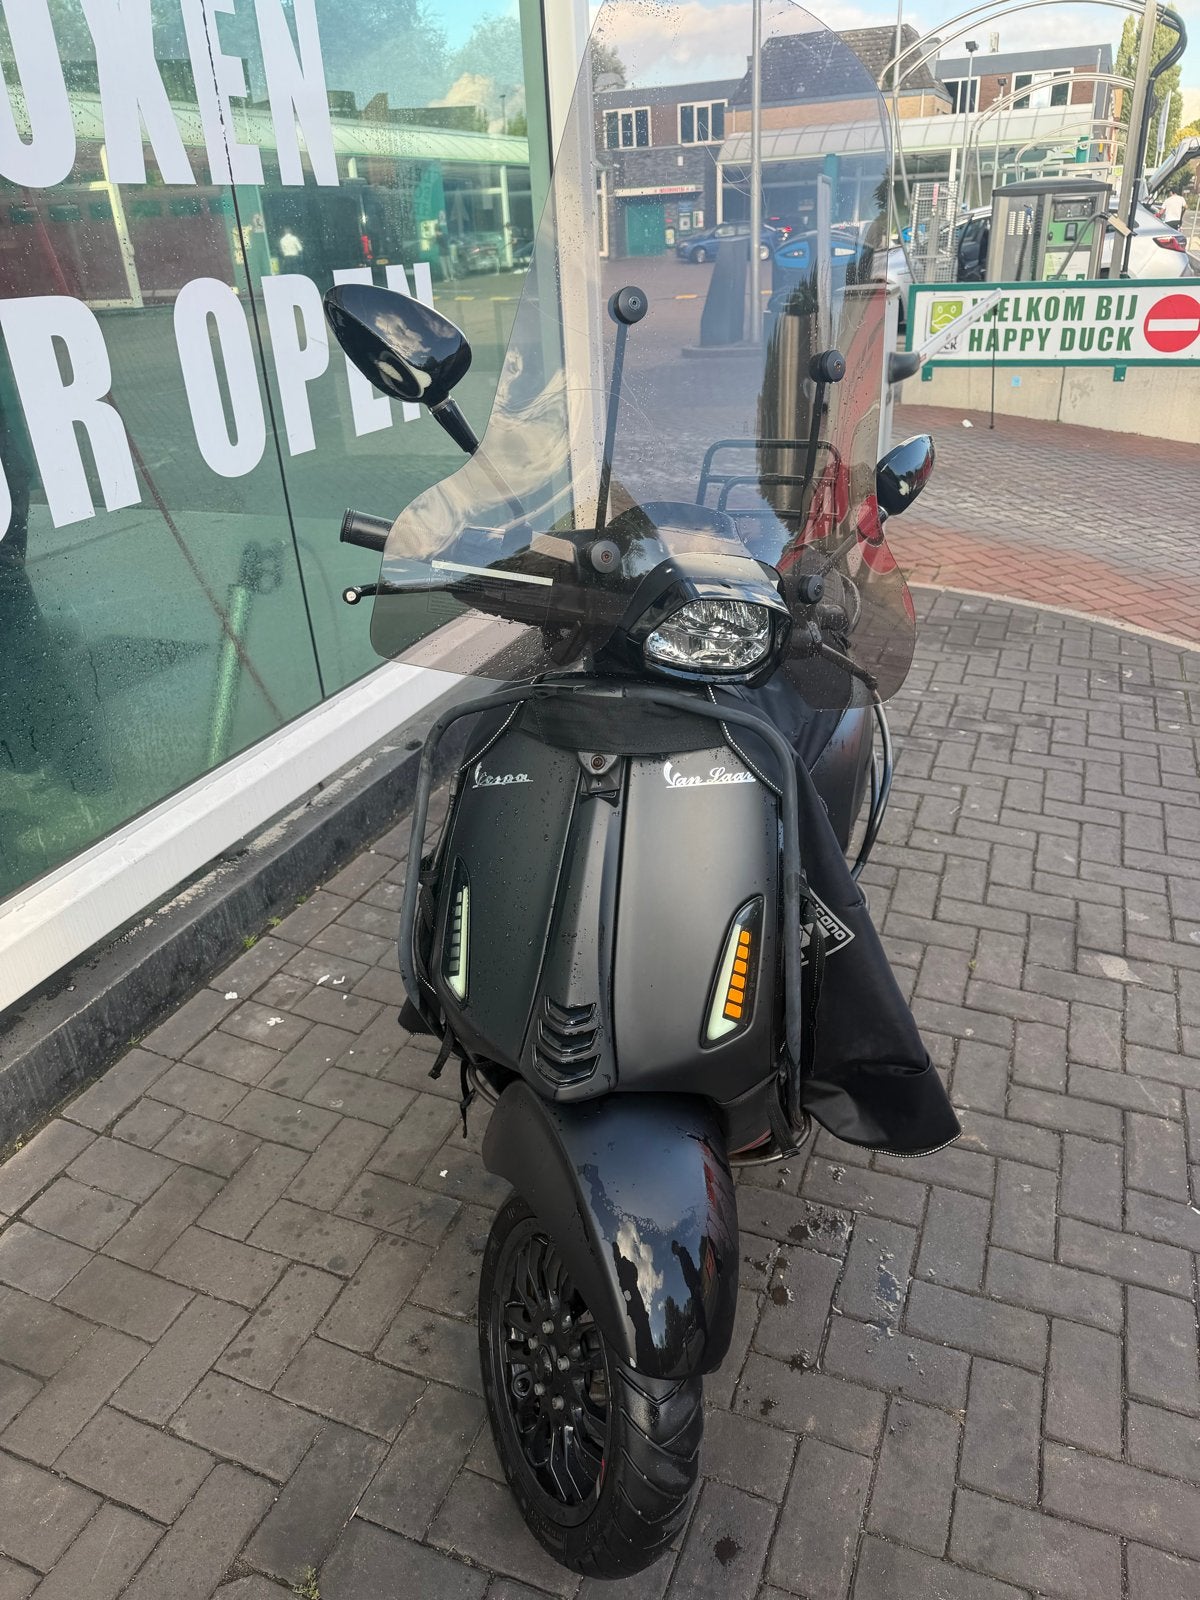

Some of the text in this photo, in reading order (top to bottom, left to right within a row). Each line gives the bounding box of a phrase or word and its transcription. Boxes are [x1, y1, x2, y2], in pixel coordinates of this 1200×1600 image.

[1095, 295, 1139, 321] BIJ
[968, 327, 1051, 352] HAPPY
[1060, 326, 1135, 352] DUCK
[472, 762, 534, 788] Vespa
[663, 762, 704, 788] Van
[815, 903, 847, 941] cano
